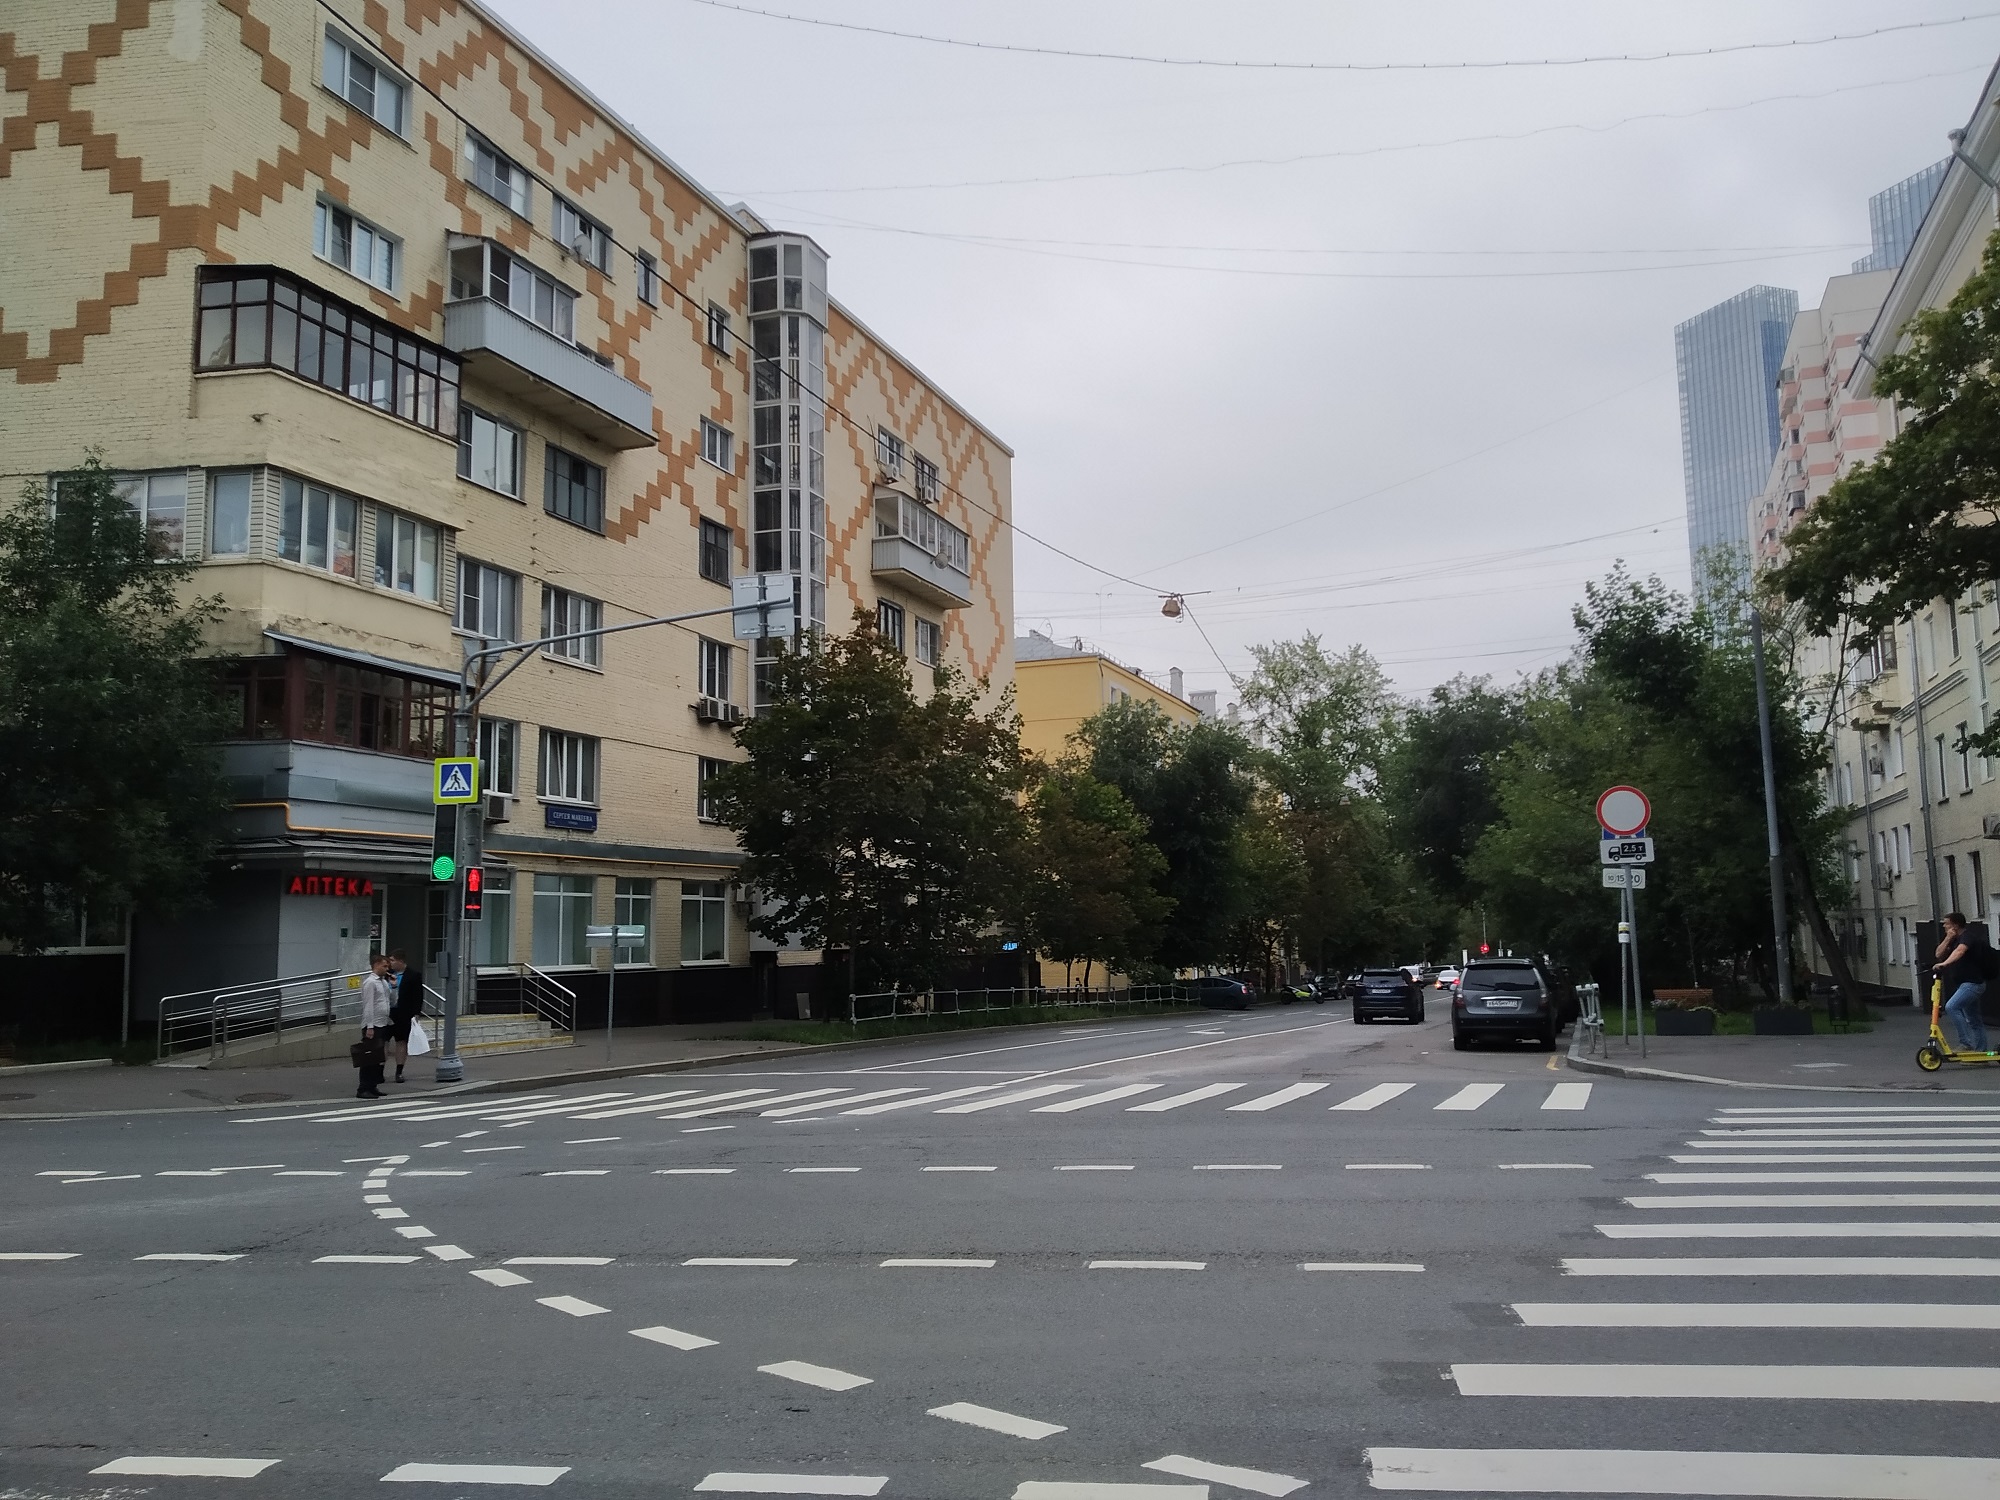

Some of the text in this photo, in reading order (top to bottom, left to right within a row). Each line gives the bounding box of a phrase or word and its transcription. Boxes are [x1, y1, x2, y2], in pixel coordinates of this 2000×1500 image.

[553, 811, 570, 820] СЕРГЕЯ
[1616, 874, 1625, 882] 15
[290, 876, 374, 896] АПТЕКА
